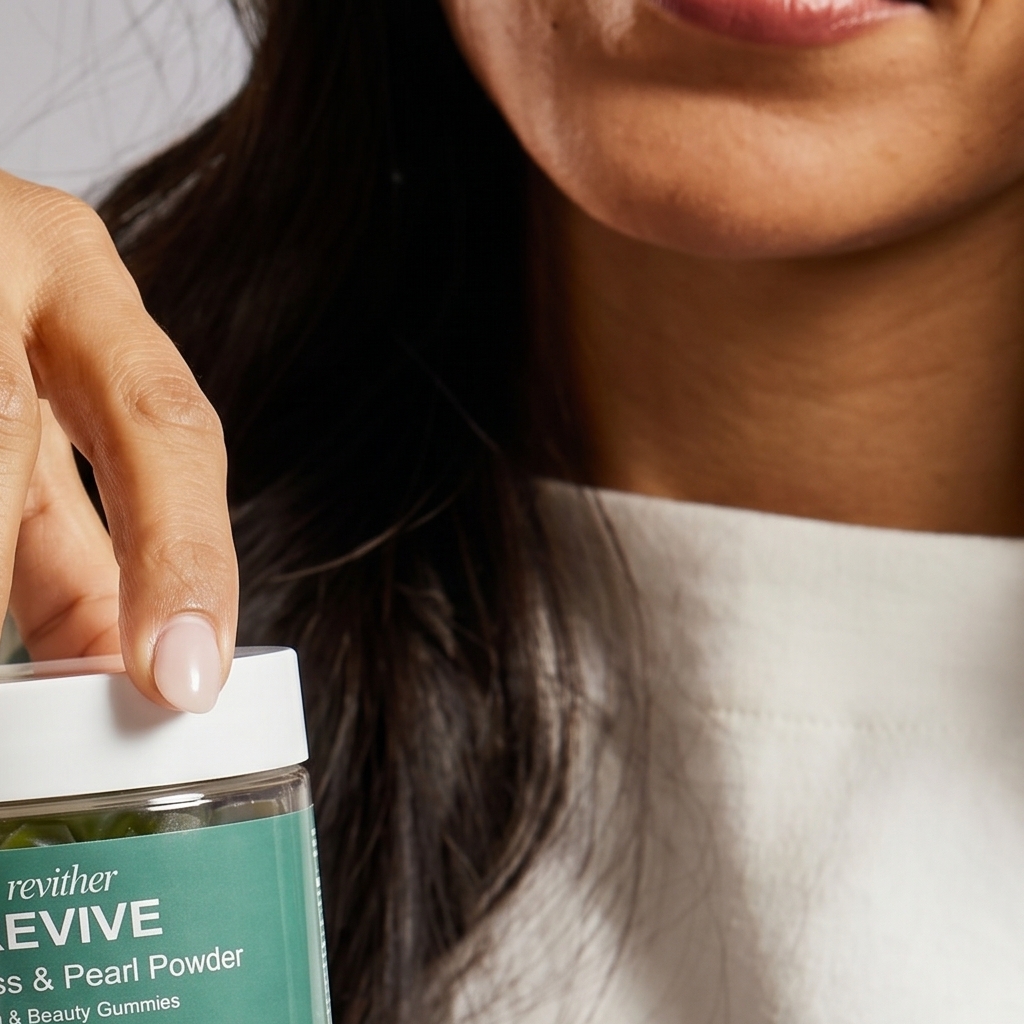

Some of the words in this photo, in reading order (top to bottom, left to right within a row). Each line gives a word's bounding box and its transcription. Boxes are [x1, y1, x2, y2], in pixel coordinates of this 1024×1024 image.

[7, 864, 118, 900] revither
[33, 967, 55, 992] &
[65, 958, 139, 988] Pearl
[149, 946, 244, 979] Powder
[28, 1003, 91, 1024] Beauty
[97, 995, 180, 1017] Gummies
